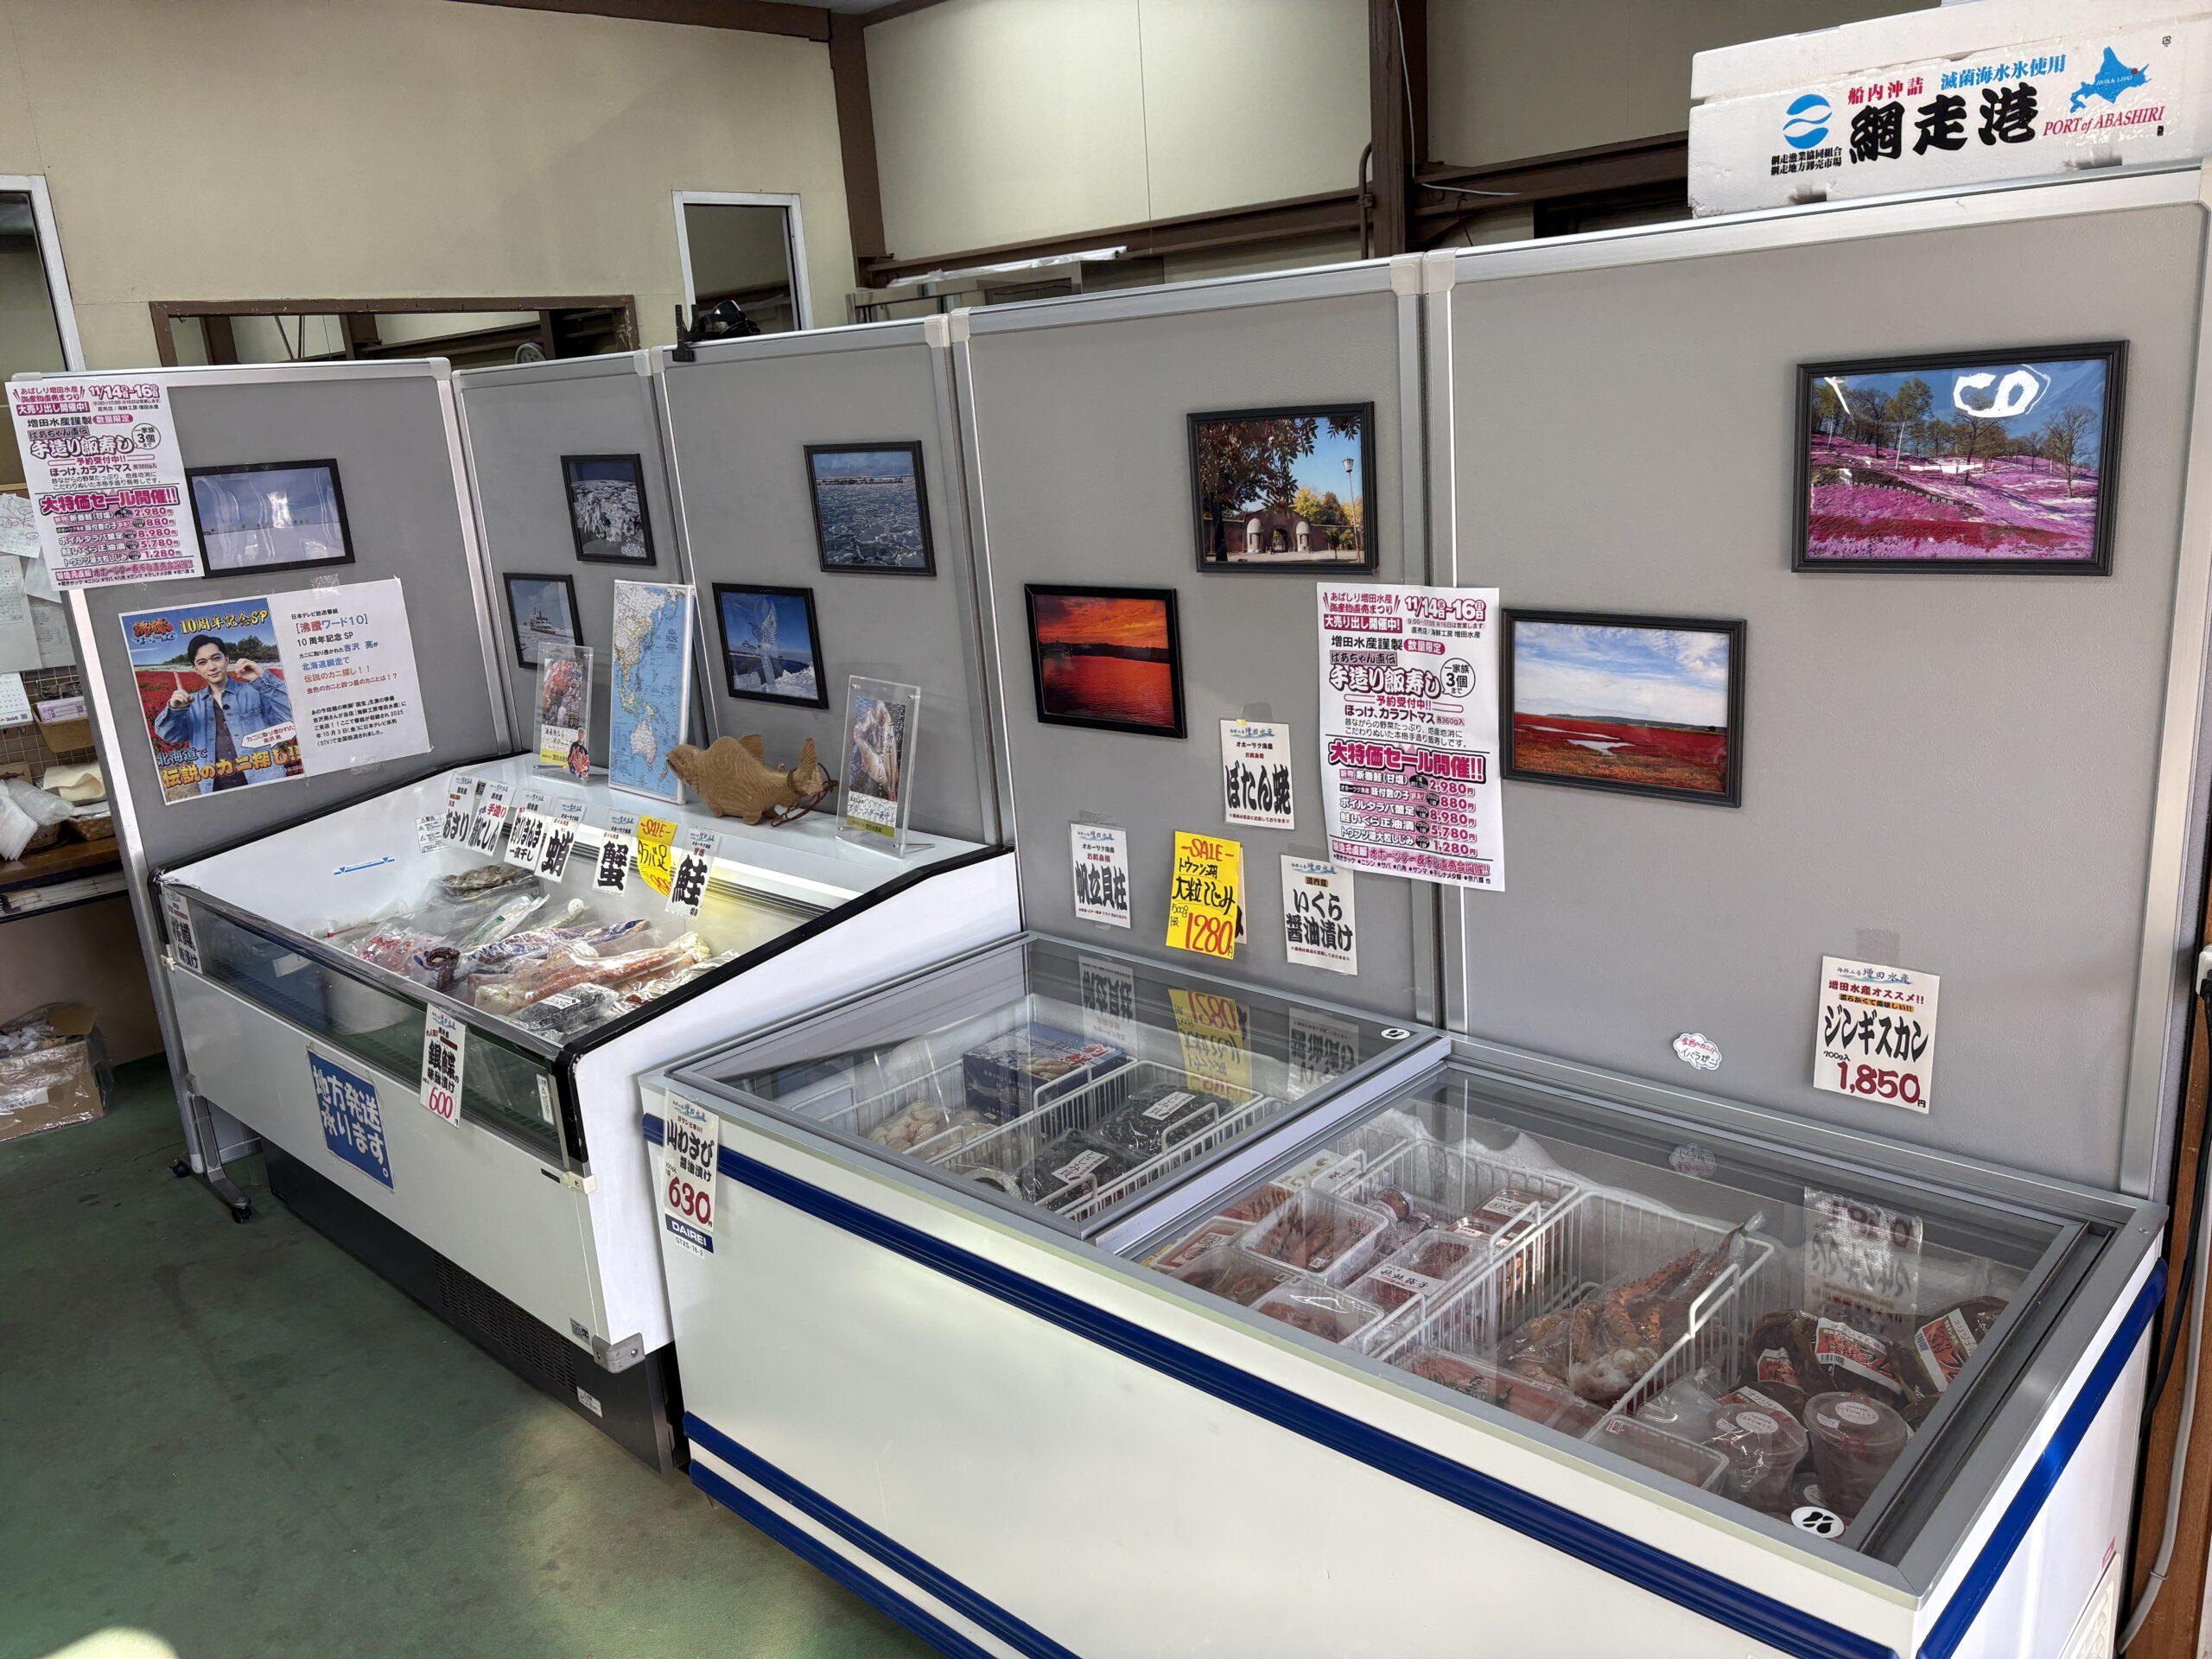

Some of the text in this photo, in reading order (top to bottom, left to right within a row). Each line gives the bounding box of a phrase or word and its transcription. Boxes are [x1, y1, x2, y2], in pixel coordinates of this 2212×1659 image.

[1941, 54, 2067, 91] 滅菌海水氷使用
[1848, 77, 1924, 105] 船内沖詰
[1849, 83, 2039, 164] 網走港
[2044, 118, 2082, 136] PORT
[2094, 105, 2165, 130] ABASHIRI
[1331, 593, 1393, 603] あばしり増田水産
[1332, 636, 1403, 651] 増田水産謹製
[1408, 640, 1441, 654] 数量限定
[1446, 674, 1467, 688] 3個
[442, 809, 469, 842] あさり
[487, 804, 507, 819] 手造り
[598, 841, 629, 891] 蟹
[671, 855, 708, 906] 鮭
[1075, 860, 1127, 911] 帆立貝柱
[1294, 888, 1342, 921] いくら
[1286, 912, 1353, 951] 醤油漬け
[1862, 968, 1911, 985] 増田水産
[1825, 1004, 1929, 1063] ジンギスカン
[1823, 1051, 1851, 1062] 700g入
[313, 1065, 382, 1132] 地方発送
[667, 1120, 715, 1167] 山わさび
[671, 1220, 707, 1247] DAIREI
